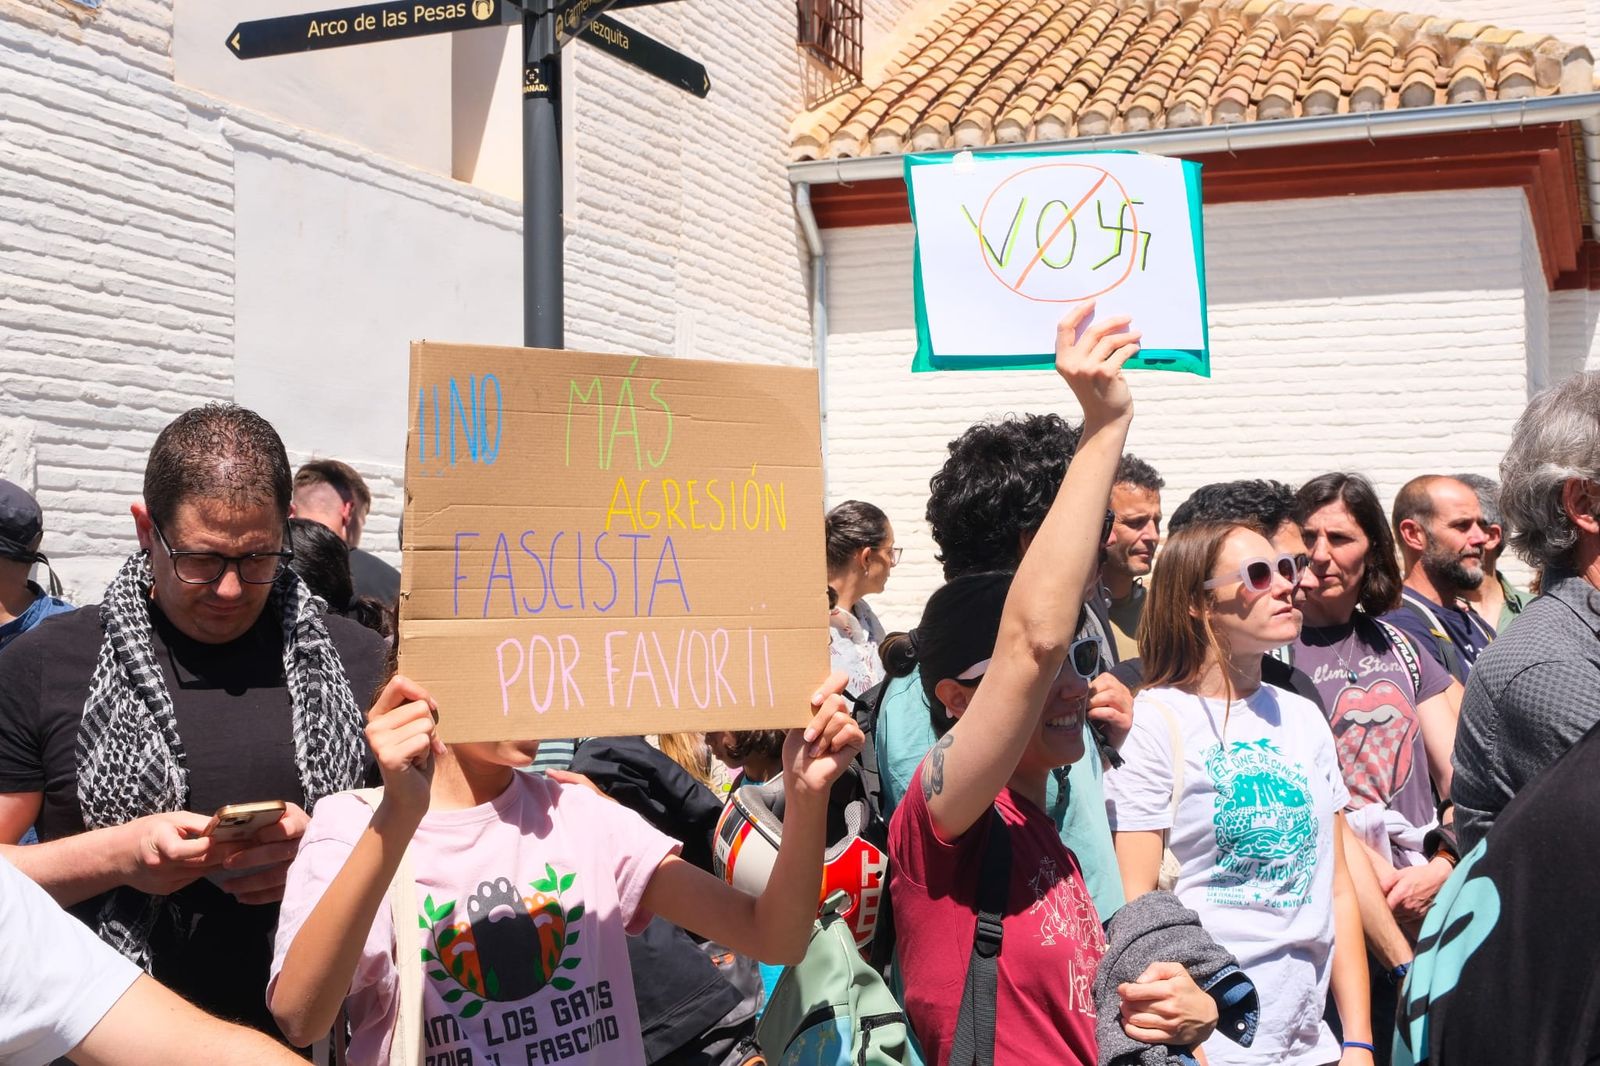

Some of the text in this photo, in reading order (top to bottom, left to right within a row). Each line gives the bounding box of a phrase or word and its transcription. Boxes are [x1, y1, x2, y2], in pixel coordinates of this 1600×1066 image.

[308, 3, 466, 38] Arco de las Pesas
[590, 19, 629, 49] ezquita
[565, 358, 673, 471] MÁS
[604, 463, 787, 531] AGRESIÓN
[454, 530, 690, 617] FASCISTA
[496, 634, 584, 716] POR
[1358, 655, 1404, 677] Ston
[483, 1006, 538, 1047] LOS
[526, 1015, 619, 1066] FASCIMO
